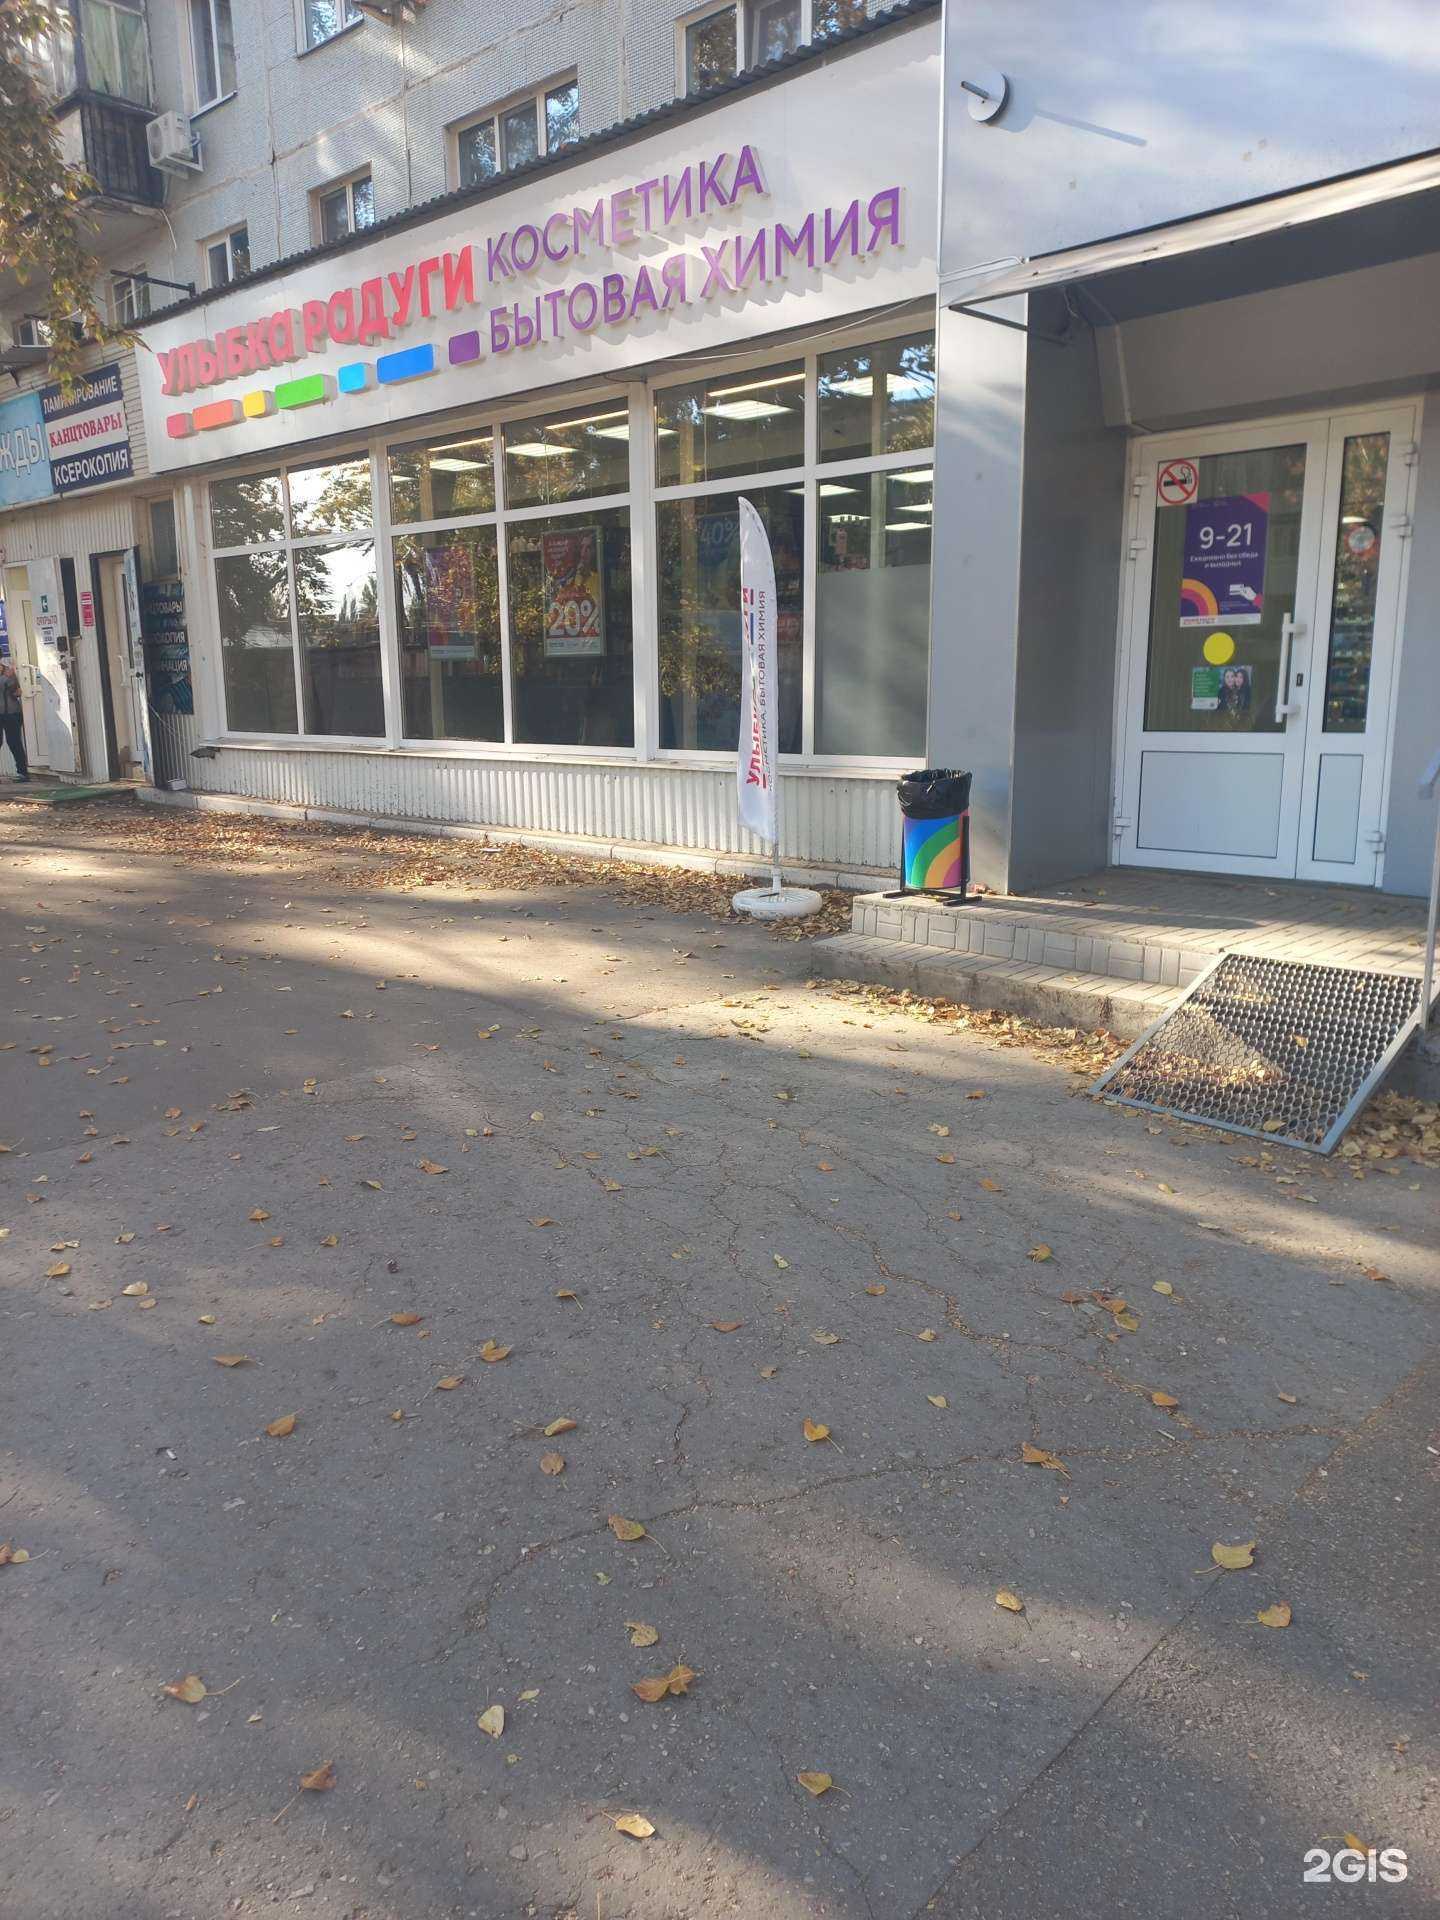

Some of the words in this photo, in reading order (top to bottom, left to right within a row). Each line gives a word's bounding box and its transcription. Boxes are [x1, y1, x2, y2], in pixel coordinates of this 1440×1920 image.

[487, 145, 764, 283] КОСМЕТИКА
[490, 253, 687, 354] БЫТОВАЯ
[700, 187, 902, 298] ХИМИЯ
[49, 412, 123, 448] КАНЦТОВАРЫ
[54, 448, 129, 486] КСЕРОКОПИЯ
[1200, 523, 1253, 549] 9-21
[758, 591, 766, 641] ХИМИЯ
